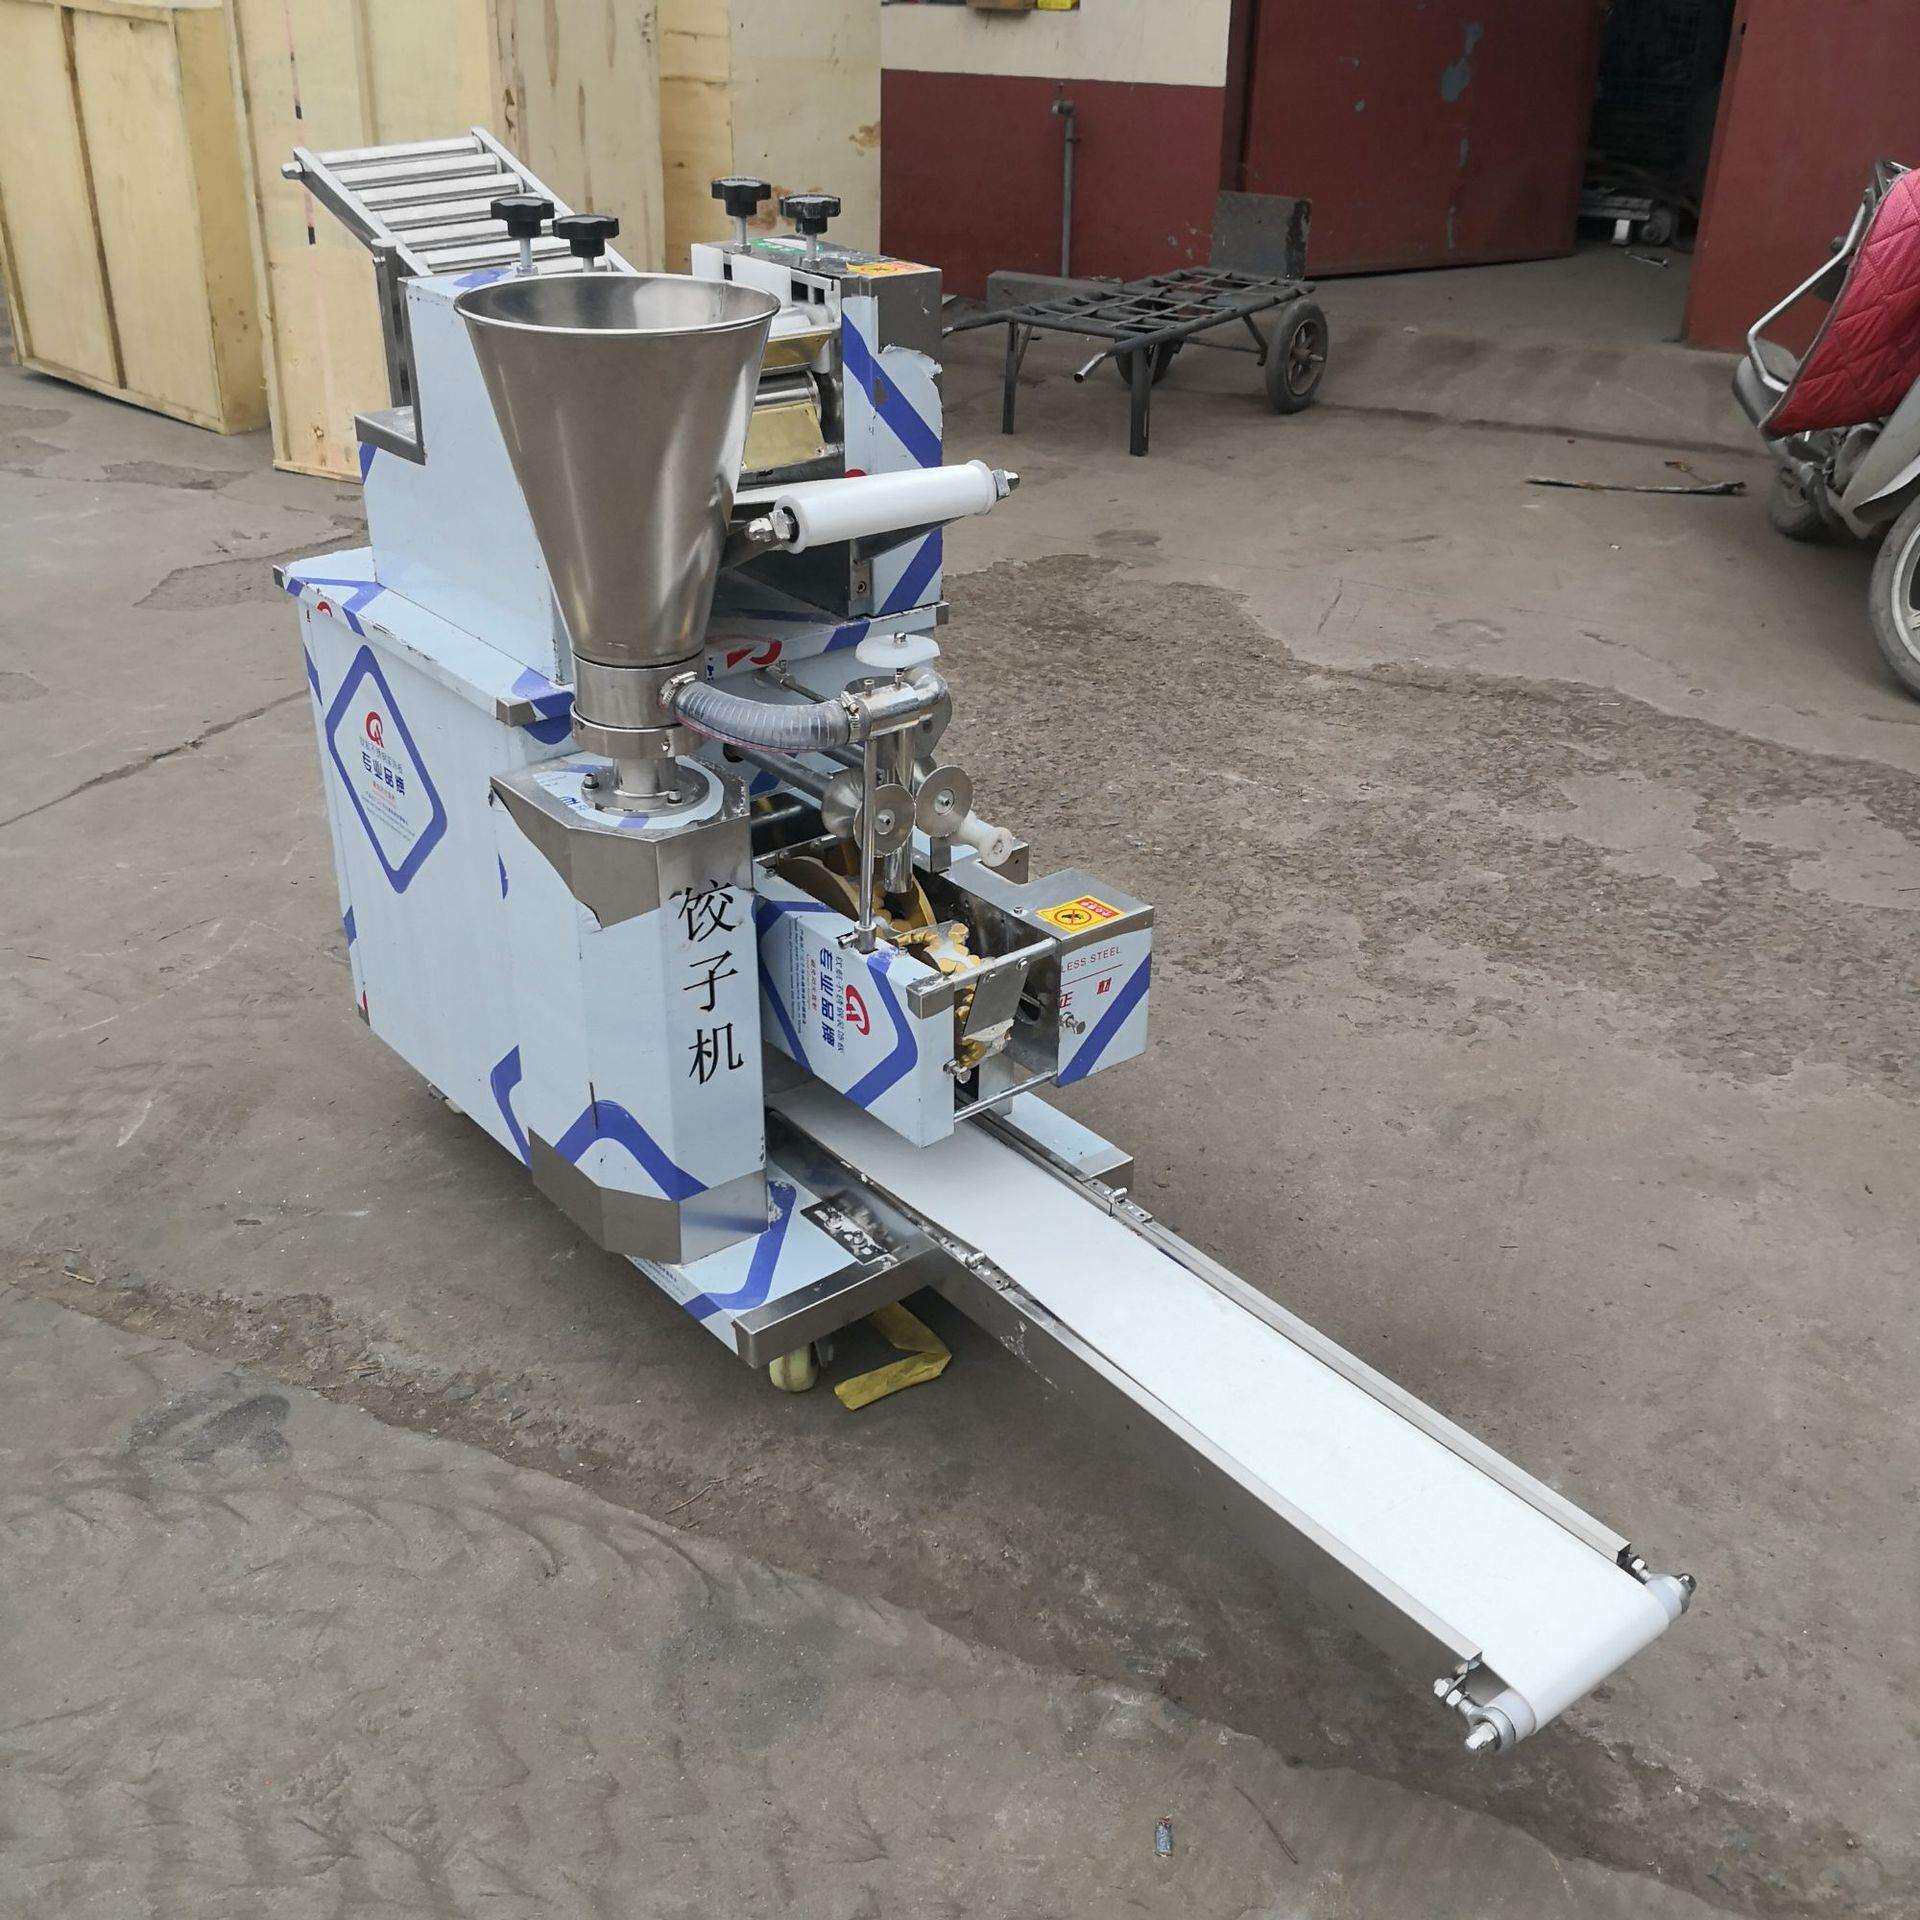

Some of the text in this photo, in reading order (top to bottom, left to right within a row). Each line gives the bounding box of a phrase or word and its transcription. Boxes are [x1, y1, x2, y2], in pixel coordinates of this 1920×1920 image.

[669, 880, 744, 1085] 饺子机
[820, 947, 835, 1048] 专业品牌
